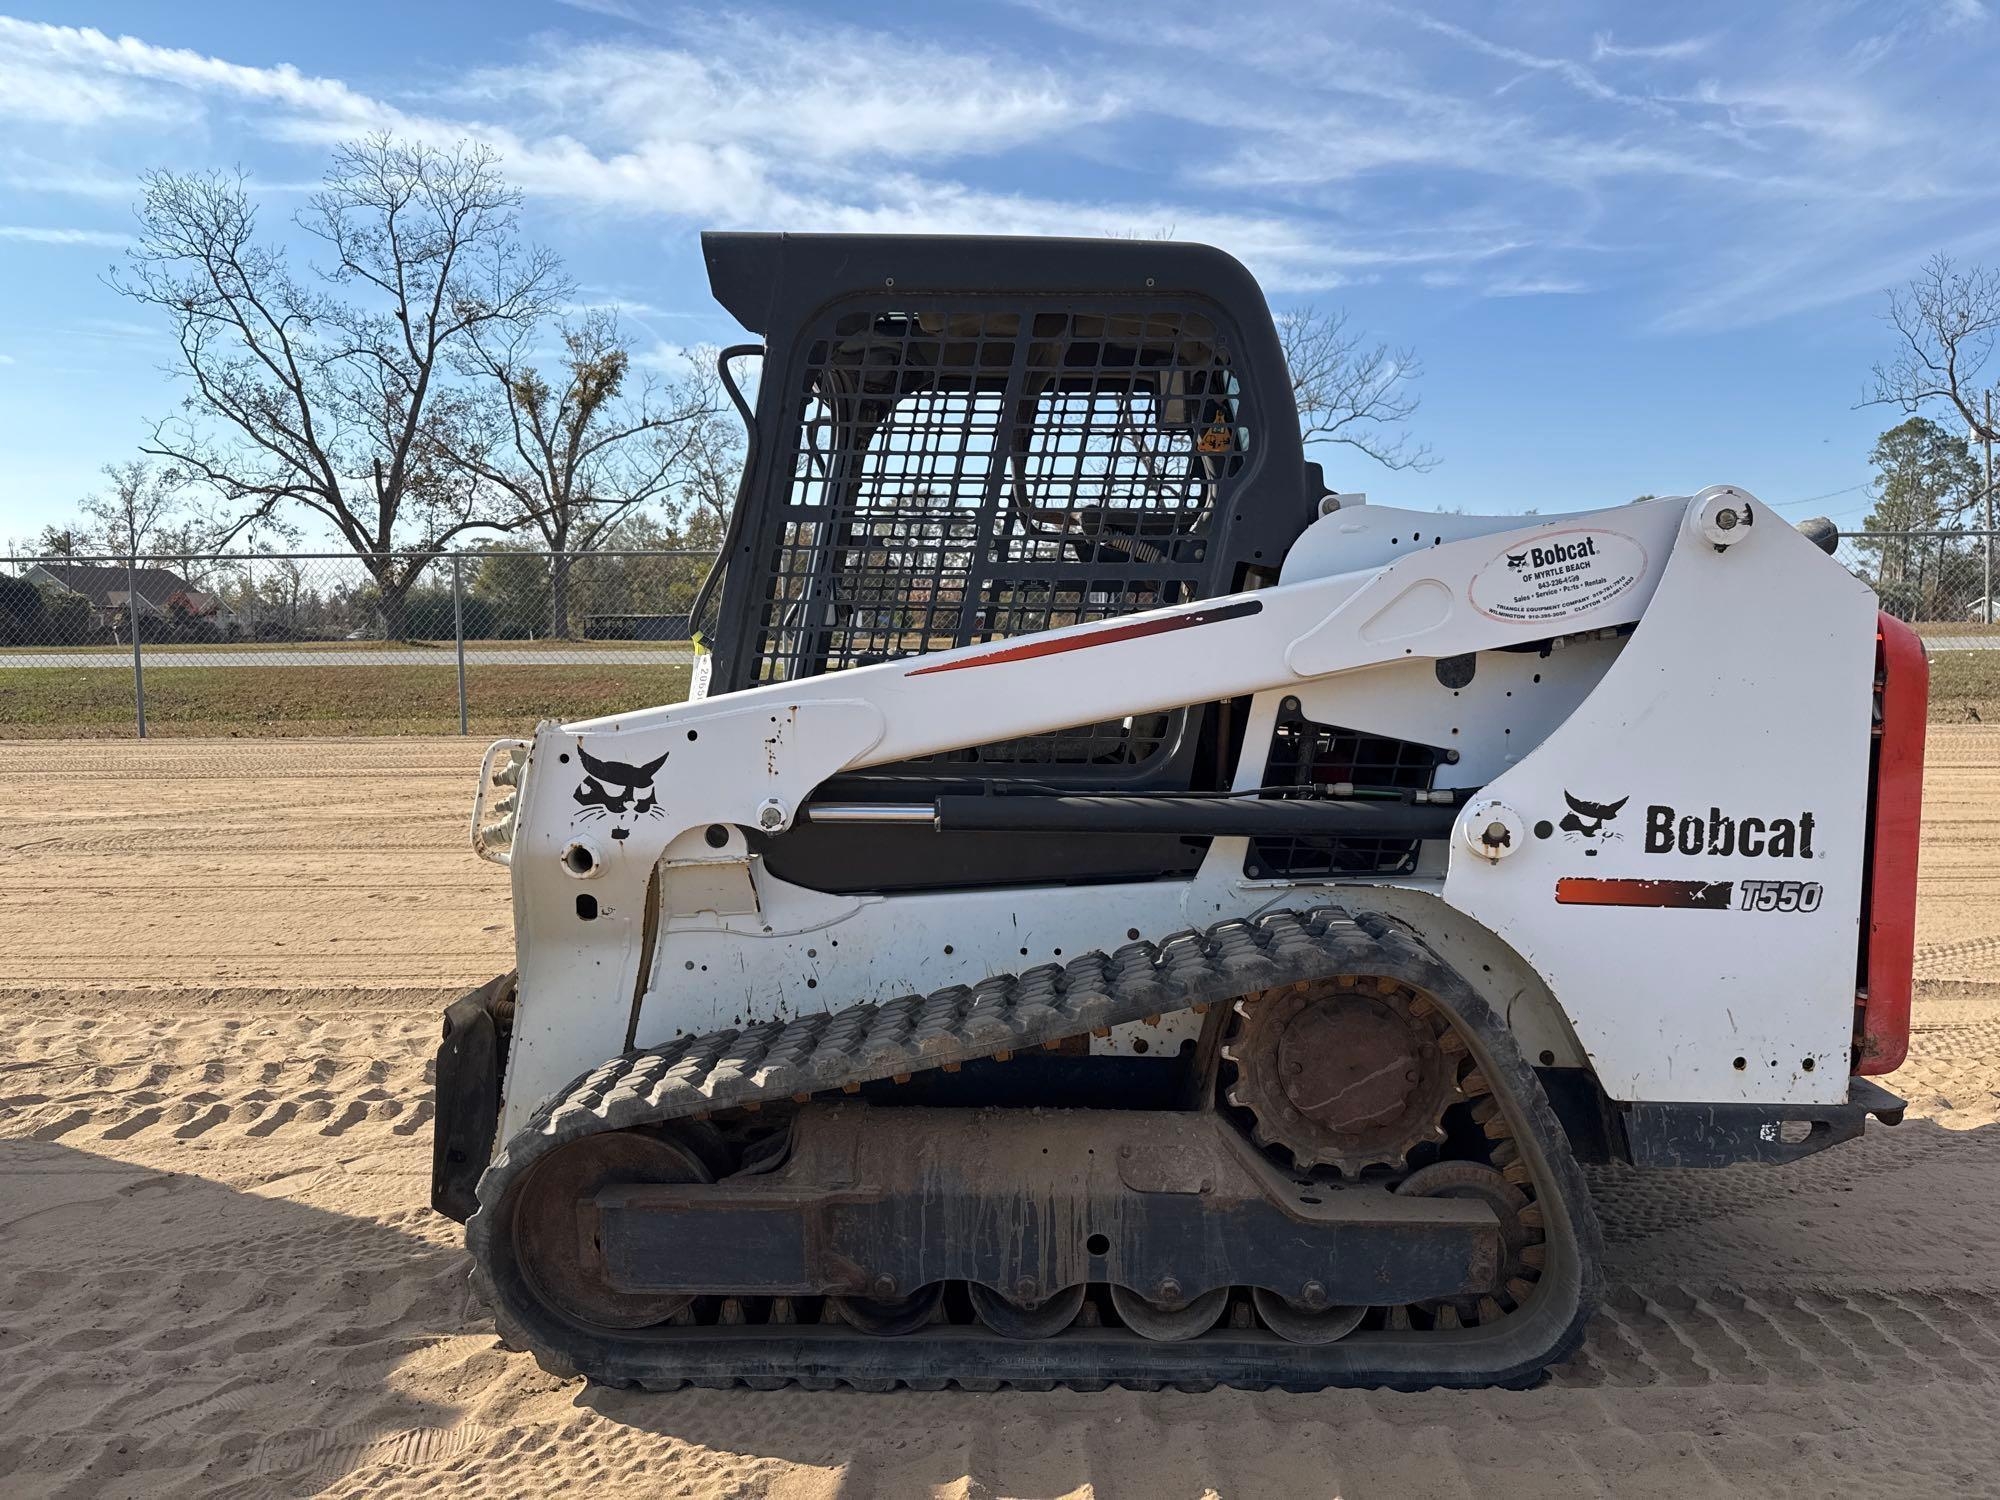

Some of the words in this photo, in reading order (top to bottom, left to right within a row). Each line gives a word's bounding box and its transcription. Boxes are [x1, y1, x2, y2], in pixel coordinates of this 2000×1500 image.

[1530, 536, 1596, 568] Bobcat
[1522, 573, 1533, 582] OF
[1533, 566, 1564, 580] MYRTLE
[1565, 560, 1591, 573] BEACH
[1513, 595, 1531, 603] Sales
[1535, 588, 1558, 598] Service
[1584, 577, 1607, 587] Rentals
[1488, 608, 1526, 619] WILMINGTON
[1574, 599, 1601, 612] CLAYTON
[1496, 603, 1525, 612] TRIANGLE
[1526, 604, 1561, 612] EQUIPMENT
[1561, 595, 1590, 608] COMPANY
[1644, 805, 1815, 859] Bobcat
[1739, 880, 1823, 912] T550
